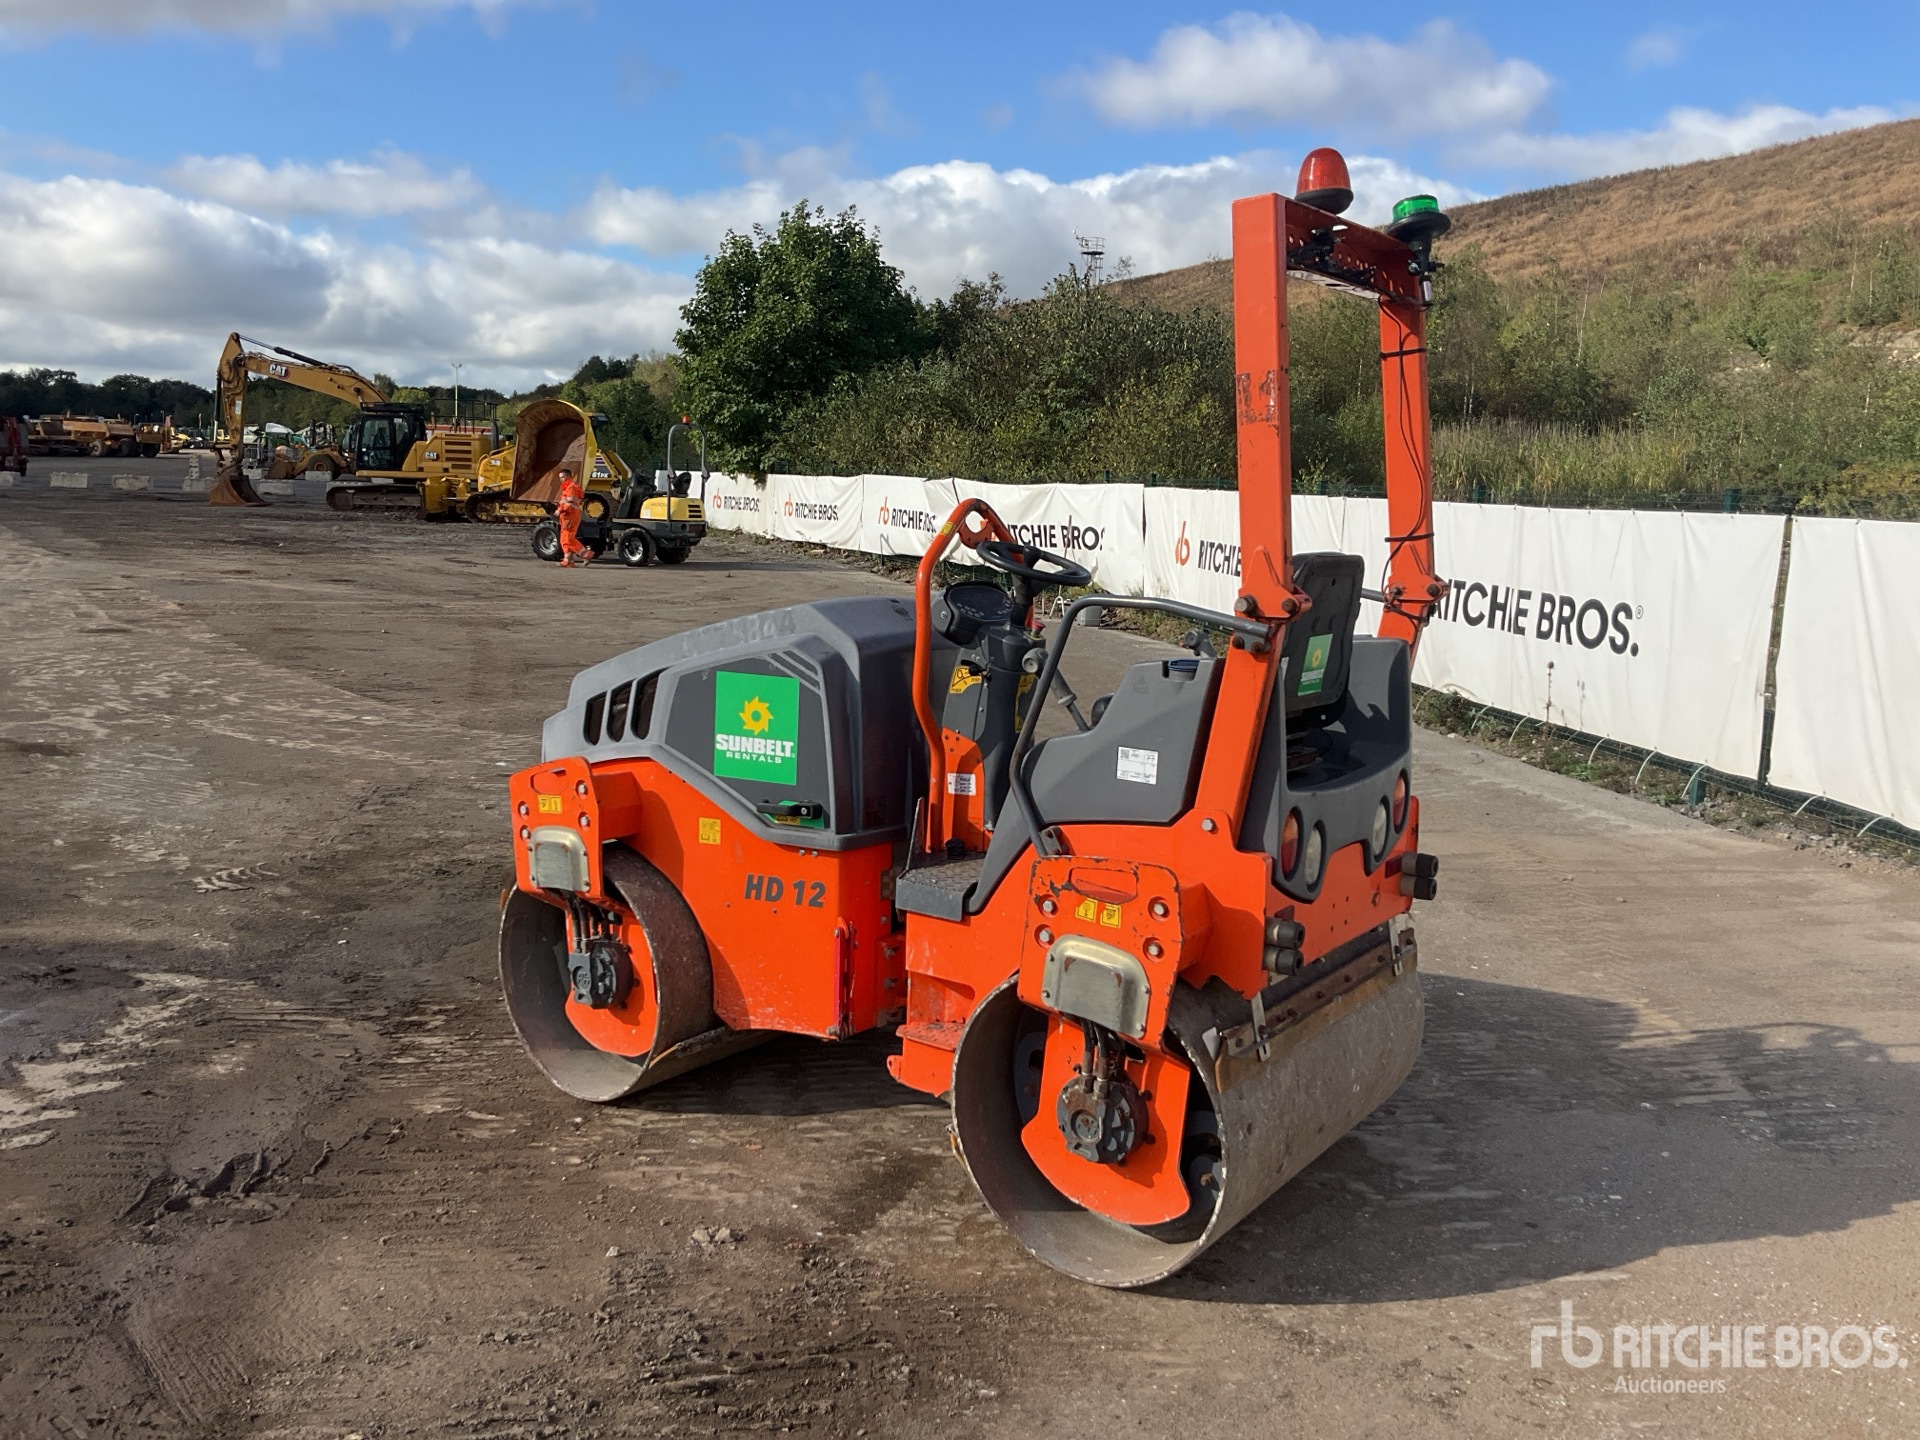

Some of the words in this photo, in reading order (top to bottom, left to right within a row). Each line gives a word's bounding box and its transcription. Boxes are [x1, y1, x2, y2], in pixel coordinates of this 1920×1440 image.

[269, 364, 287, 377] CAT
[425, 451, 438, 460] CAT
[724, 496, 741, 512] RITCHIE
[795, 502, 817, 519] RITCHIE
[819, 504, 839, 521] BROS.
[891, 508, 923, 530] RITCHIE
[1198, 540, 1241, 577] RITCHIE
[716, 733, 794, 757] SUNBELT
[726, 751, 782, 764] RENTALS
[744, 873, 785, 902] HD
[792, 880, 827, 908] 12
